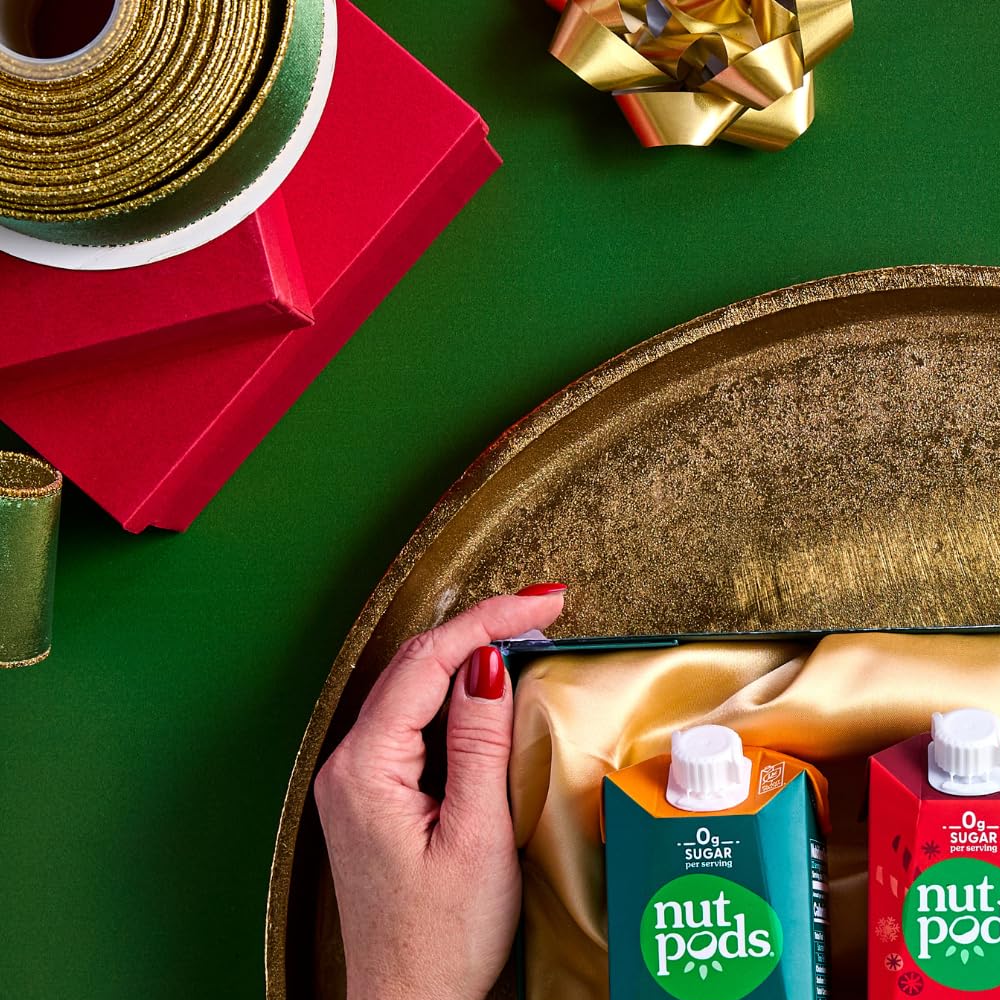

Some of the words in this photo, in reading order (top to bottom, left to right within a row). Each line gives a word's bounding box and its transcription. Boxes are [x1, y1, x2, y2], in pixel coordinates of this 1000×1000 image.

[962, 811, 985, 831] 0g
[696, 828, 719, 847] 0g
[950, 832, 997, 844] SUGAR
[685, 848, 732, 859] SUGAR
[950, 845, 964, 853] per
[966, 844, 997, 853] serving
[685, 861, 699, 869] per
[701, 860, 732, 868] serving
[917, 876, 994, 912] nut
[654, 891, 731, 928] nut
